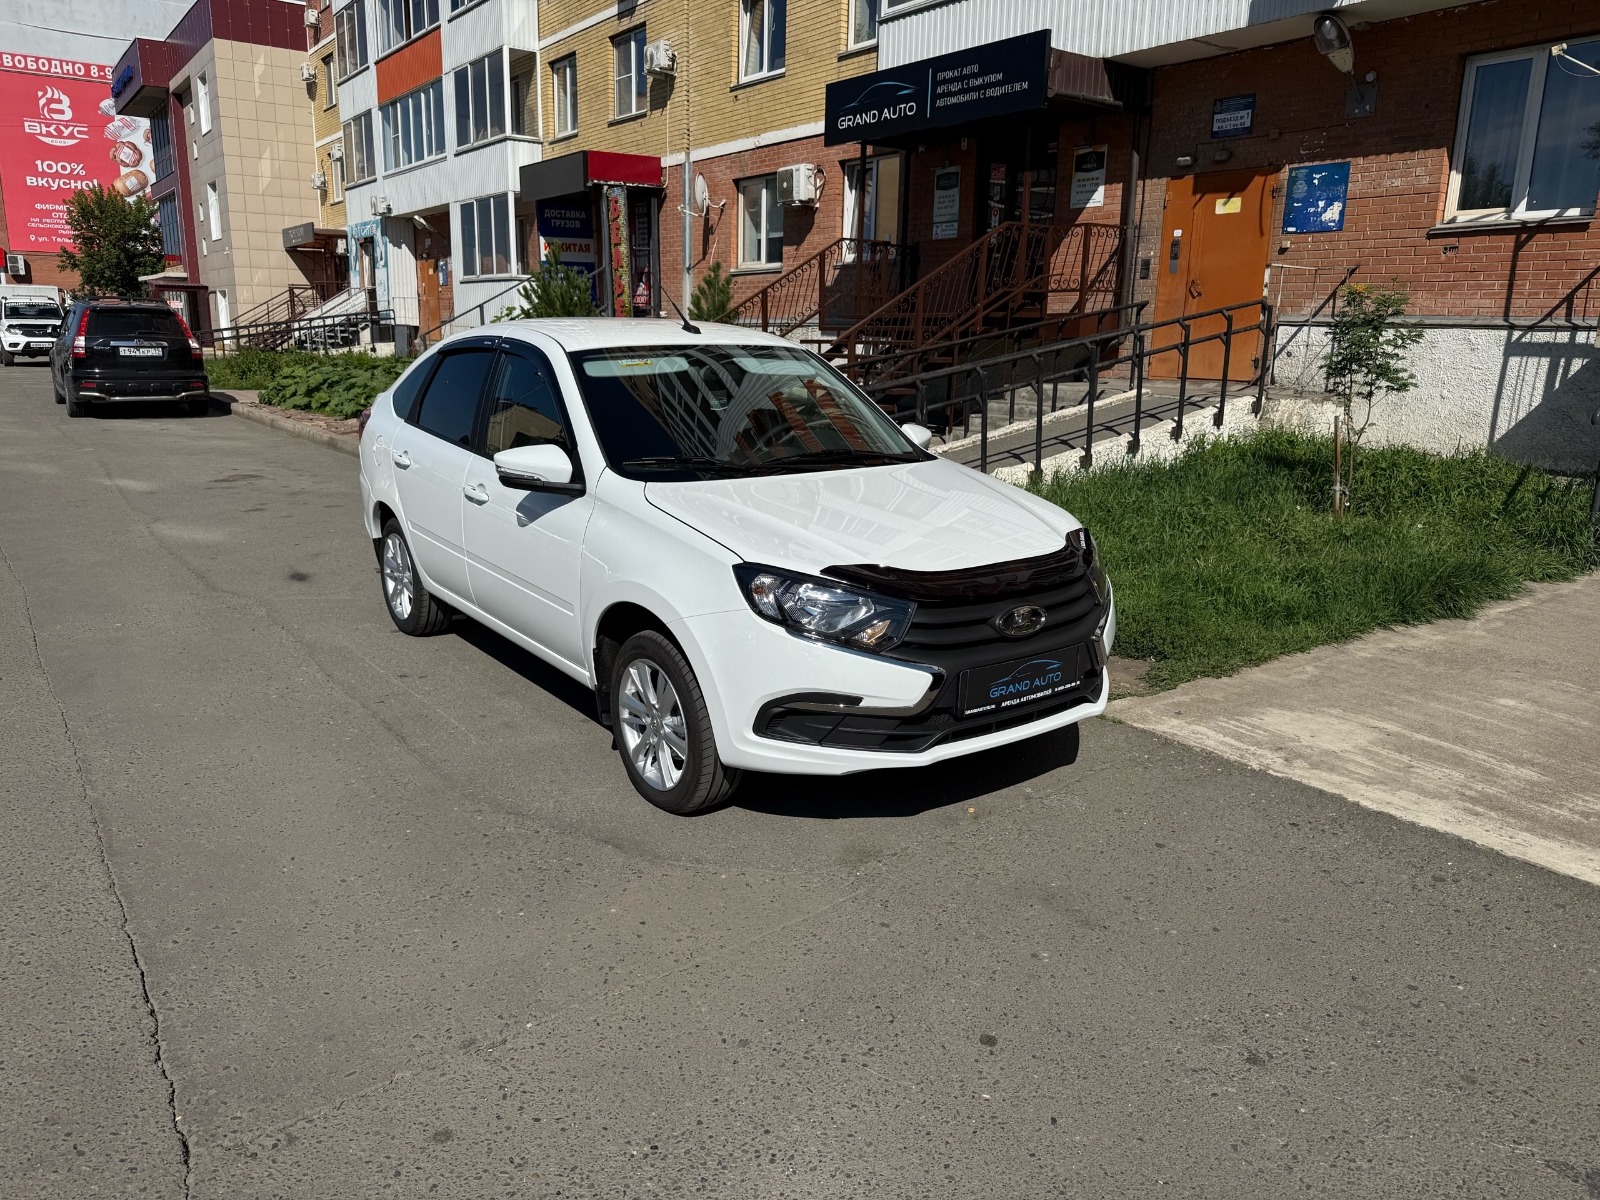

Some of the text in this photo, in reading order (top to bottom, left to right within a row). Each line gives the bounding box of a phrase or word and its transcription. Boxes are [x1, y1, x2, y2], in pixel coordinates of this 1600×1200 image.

[0, 53, 85, 76] ВОБОДНО
[937, 64, 979, 81] ПРОКАТ АВТО
[936, 72, 1003, 94] АРЕНДА С ВЫКУПОМ
[935, 81, 1029, 107] АВТОМОБИЛИ С ВОДИТЕЛЕМ
[838, 102, 917, 129] GRAND AUTO
[1215, 116, 1239, 124] ПОДЪЕЗД
[24, 121, 89, 139] ВКУС
[35, 159, 86, 176] 100%
[26, 176, 98, 190] ВКУСНО!
[544, 209, 587, 219] ДОСТАВКА
[551, 219, 581, 229] ГРУЗОВ
[560, 242, 591, 253] КИТАЯ
[989, 680, 1030, 698] GRAND
[1033, 672, 1061, 688] AUTO
